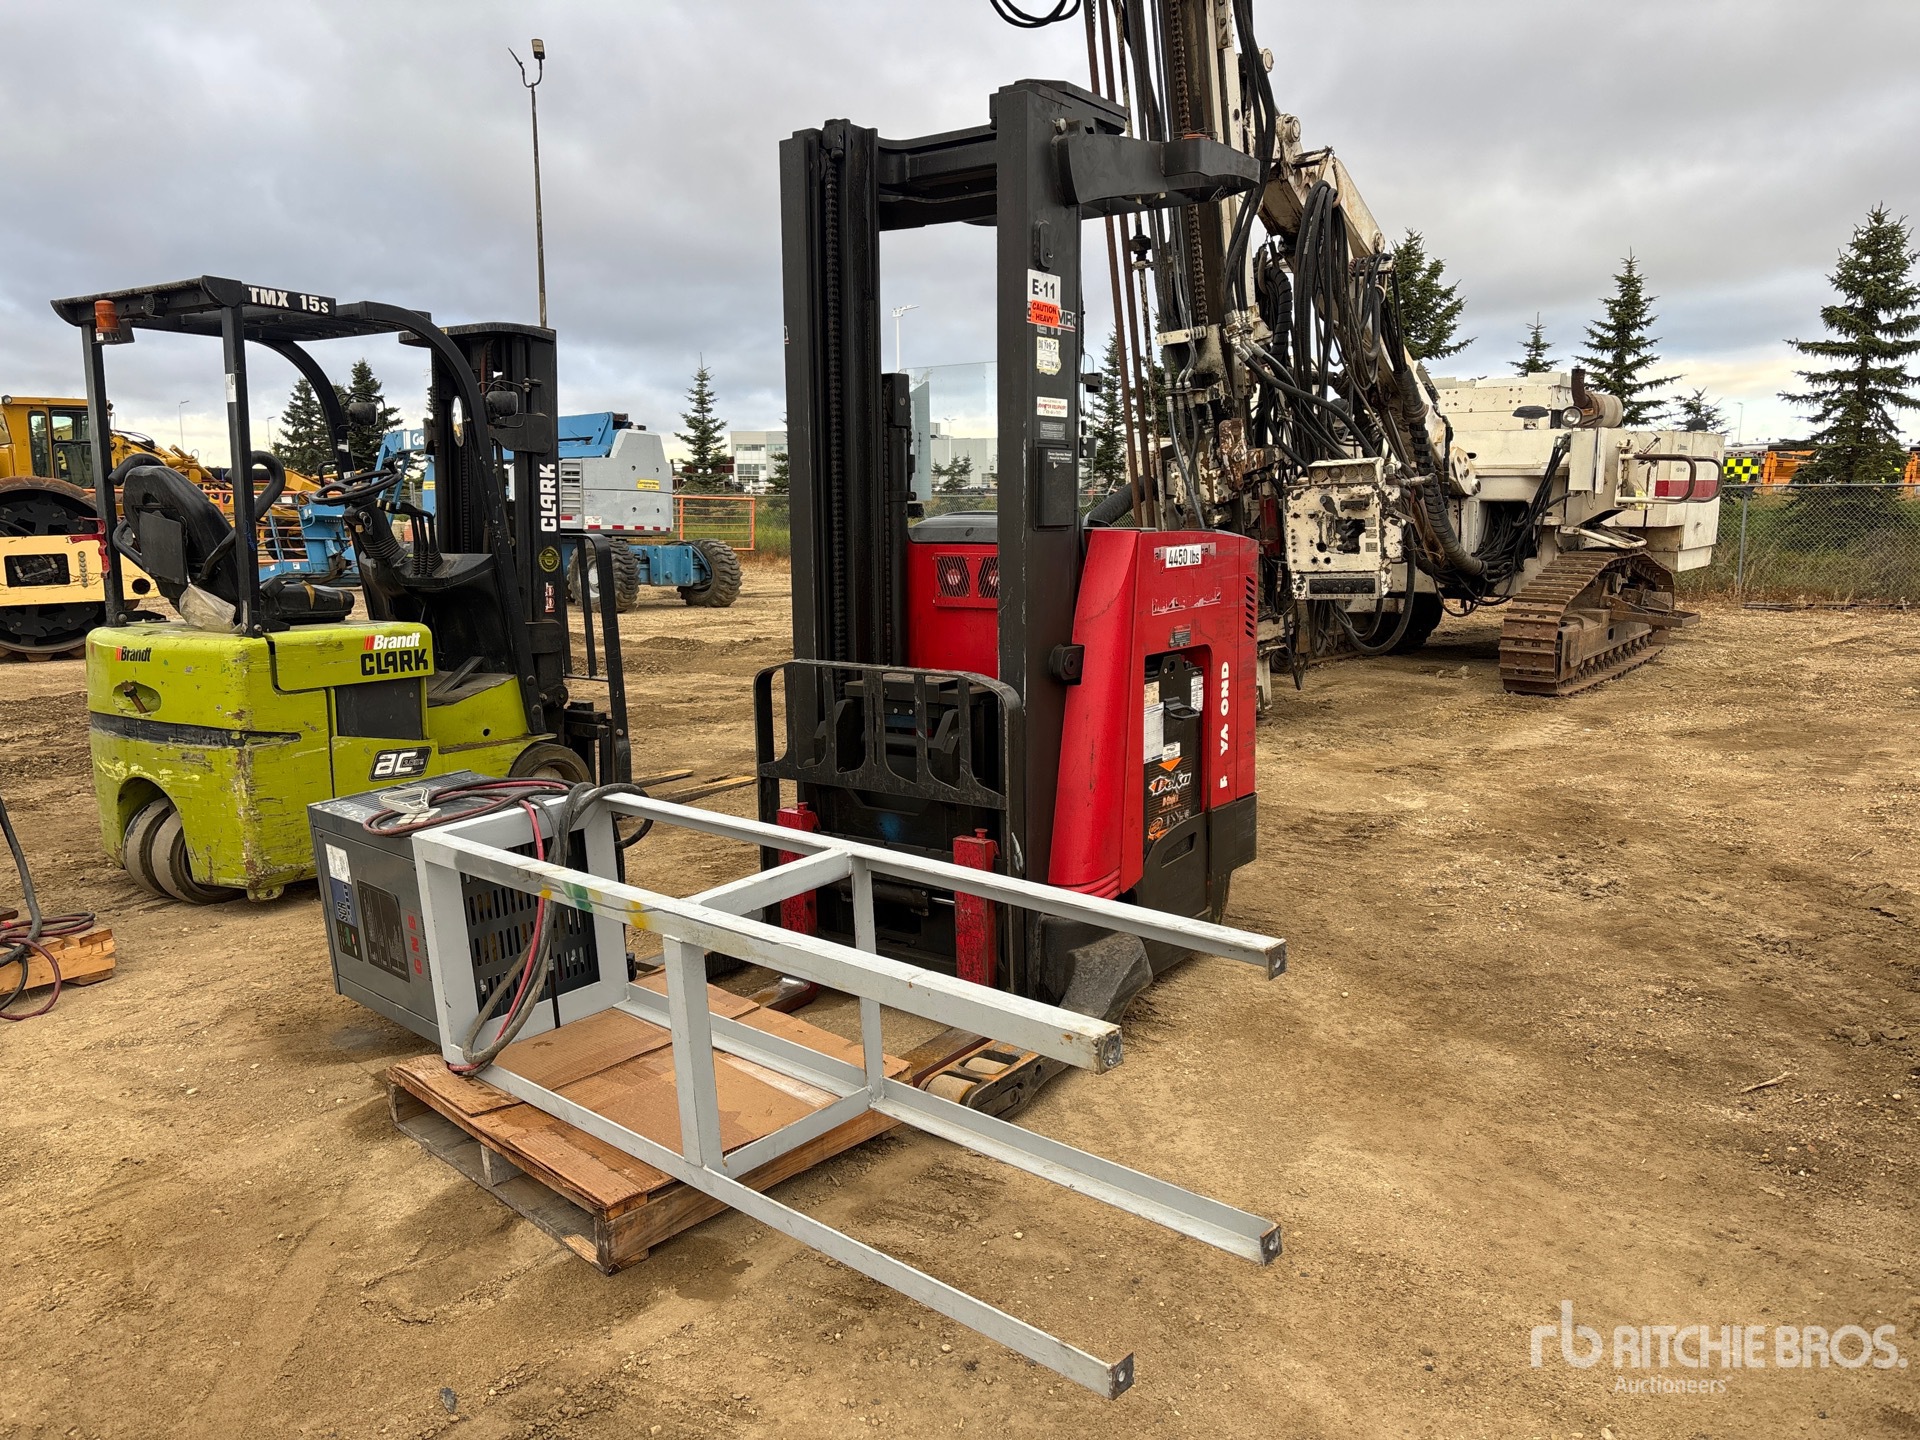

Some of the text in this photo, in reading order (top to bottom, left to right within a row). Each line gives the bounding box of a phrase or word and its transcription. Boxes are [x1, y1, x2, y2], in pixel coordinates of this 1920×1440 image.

[248, 286, 290, 308] TMX
[1031, 278, 1056, 300] E-11
[1031, 301, 1057, 315] CAUTION
[1035, 313, 1054, 324] HEAVY
[538, 463, 557, 532] CLARK
[1168, 548, 1188, 566] 4450
[1189, 548, 1200, 564] lbs
[373, 632, 421, 651] Brandt
[120, 645, 152, 662] Brandt
[360, 648, 429, 677] CLARK
